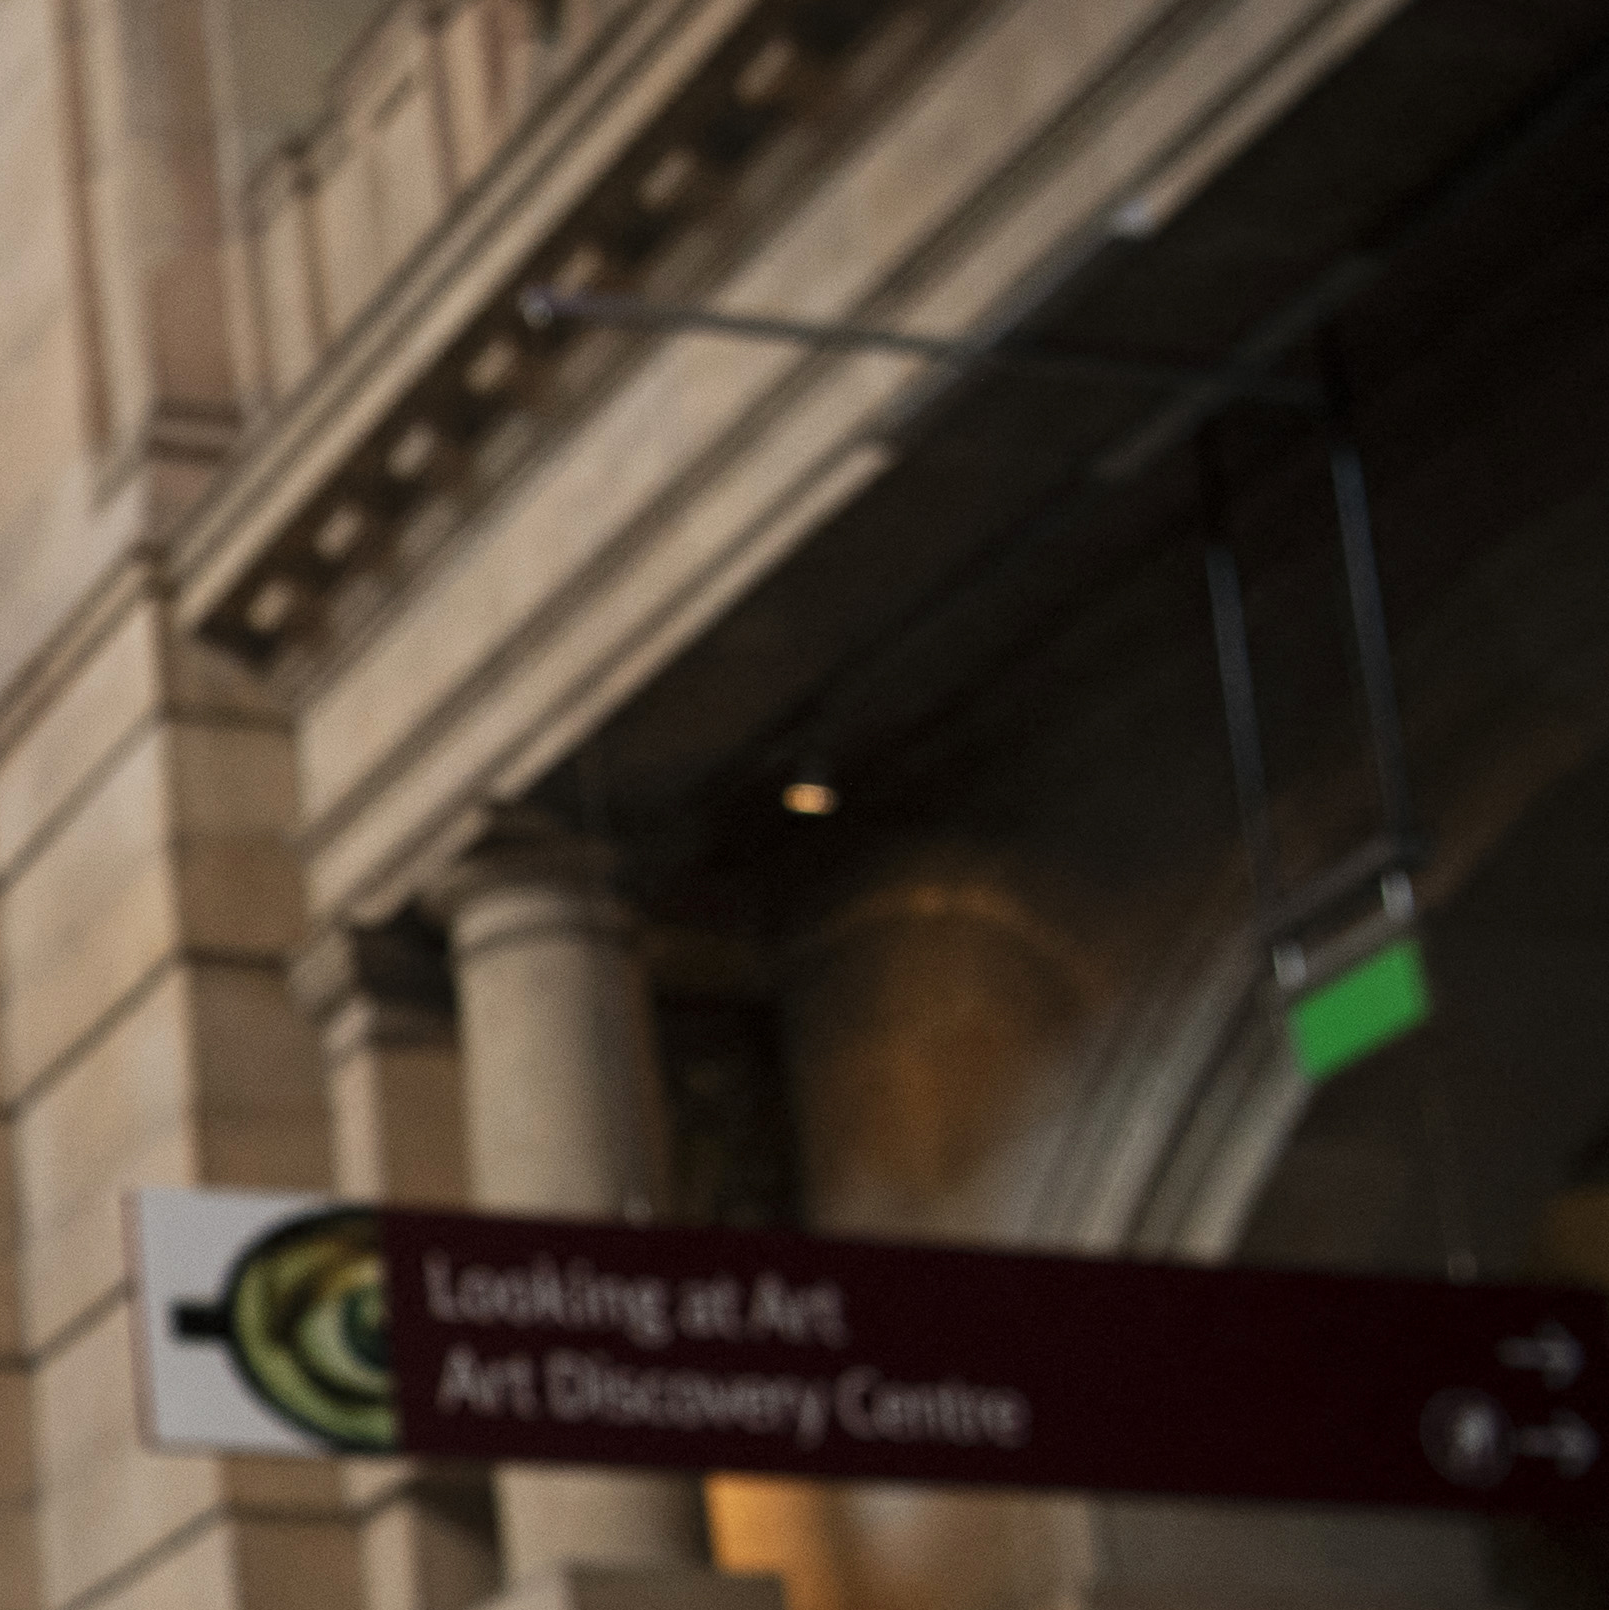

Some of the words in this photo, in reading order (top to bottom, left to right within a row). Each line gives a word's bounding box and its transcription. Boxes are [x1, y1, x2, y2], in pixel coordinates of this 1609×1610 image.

[423, 1249, 675, 1348] Looking
[745, 1269, 849, 1349] Art
[437, 1341, 536, 1422] Art
[541, 1345, 829, 1450] Discovery
